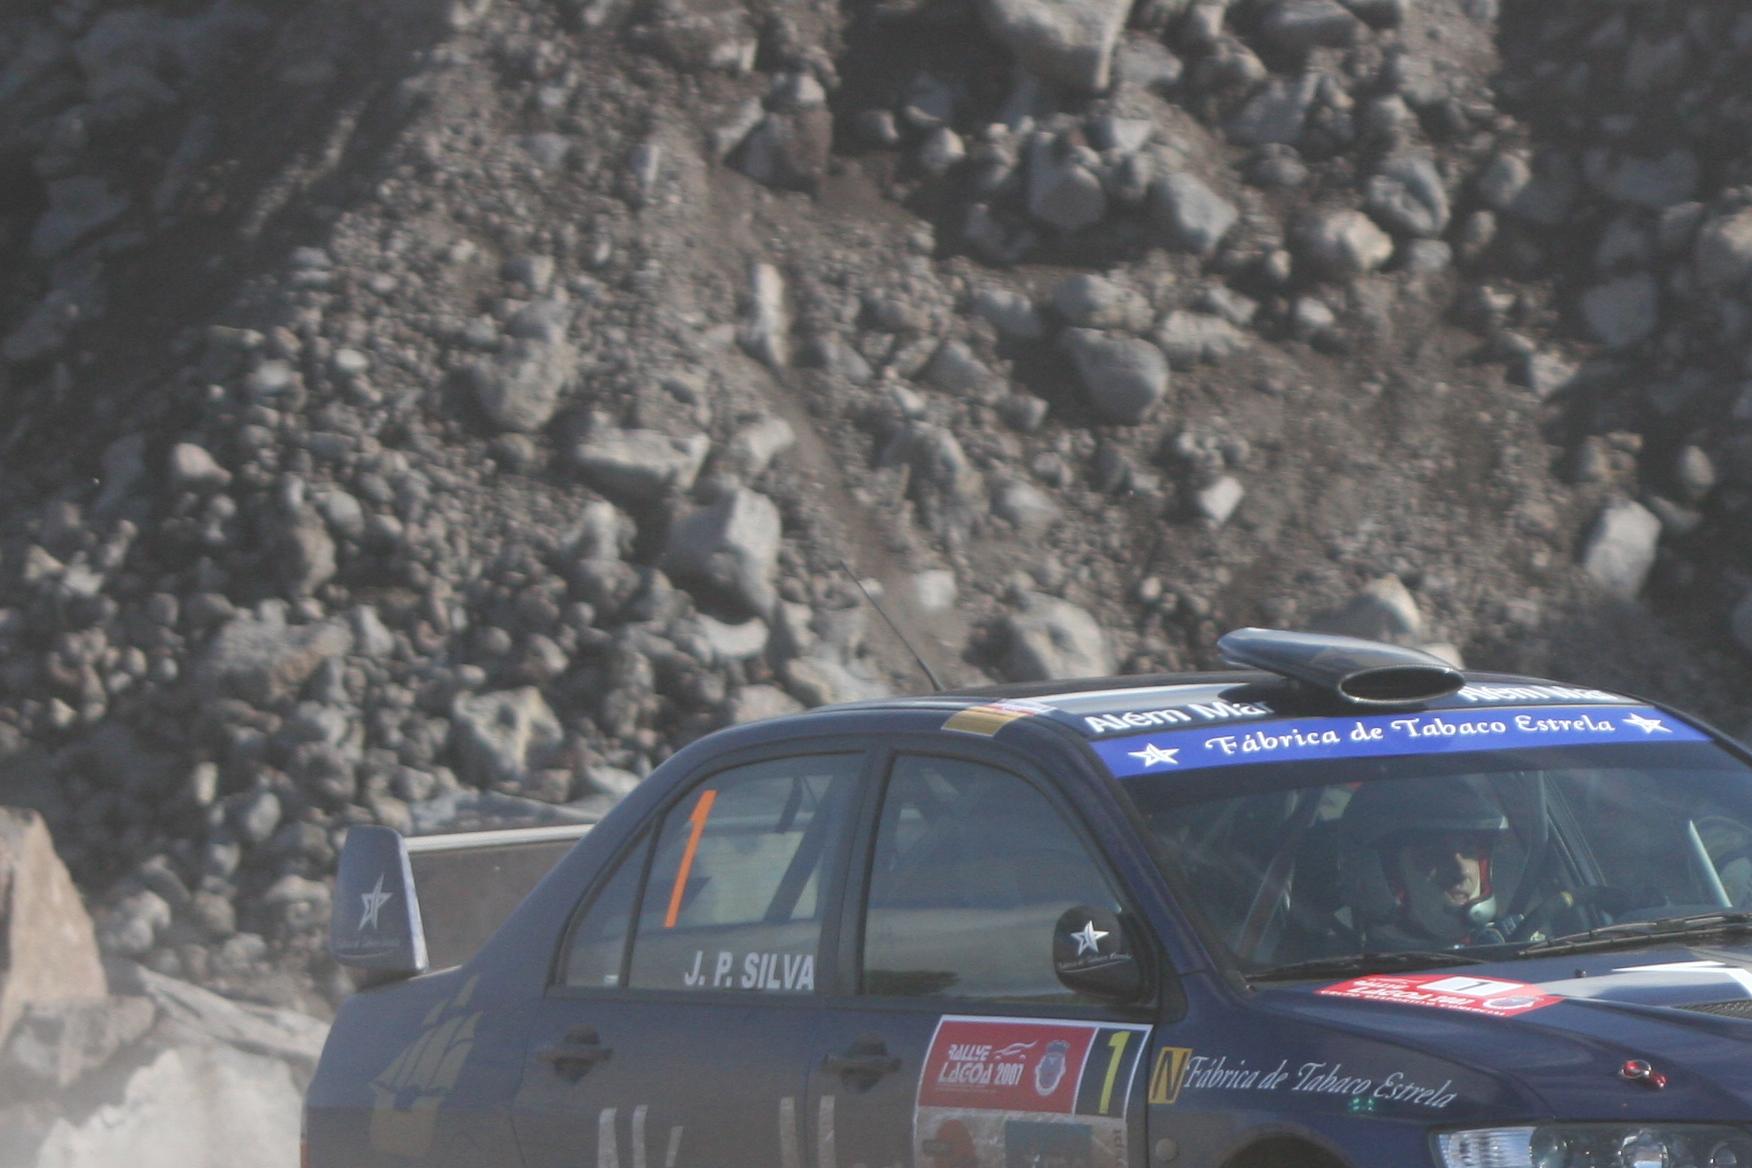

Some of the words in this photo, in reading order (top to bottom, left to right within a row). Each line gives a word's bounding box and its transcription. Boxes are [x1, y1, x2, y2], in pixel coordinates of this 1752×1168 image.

[1084, 707, 1192, 733] Além
[1187, 700, 1275, 719] Mar
[1204, 728, 1341, 755] Fábrica
[1350, 721, 1384, 742] de
[1390, 716, 1506, 738] Tabaco
[1514, 713, 1617, 732] Estrela
[683, 950, 706, 987] J.
[713, 951, 734, 987] P.
[740, 952, 816, 991] SILVA
[937, 1061, 993, 1085] LAGOA
[948, 1043, 993, 1062] RALLYE
[1098, 1030, 1132, 1115] 1
[1184, 1055, 1257, 1089] Fábrica
[1257, 1058, 1289, 1090] de
[1292, 1061, 1372, 1096] Tabaco
[1372, 1071, 1458, 1109] Estrela
